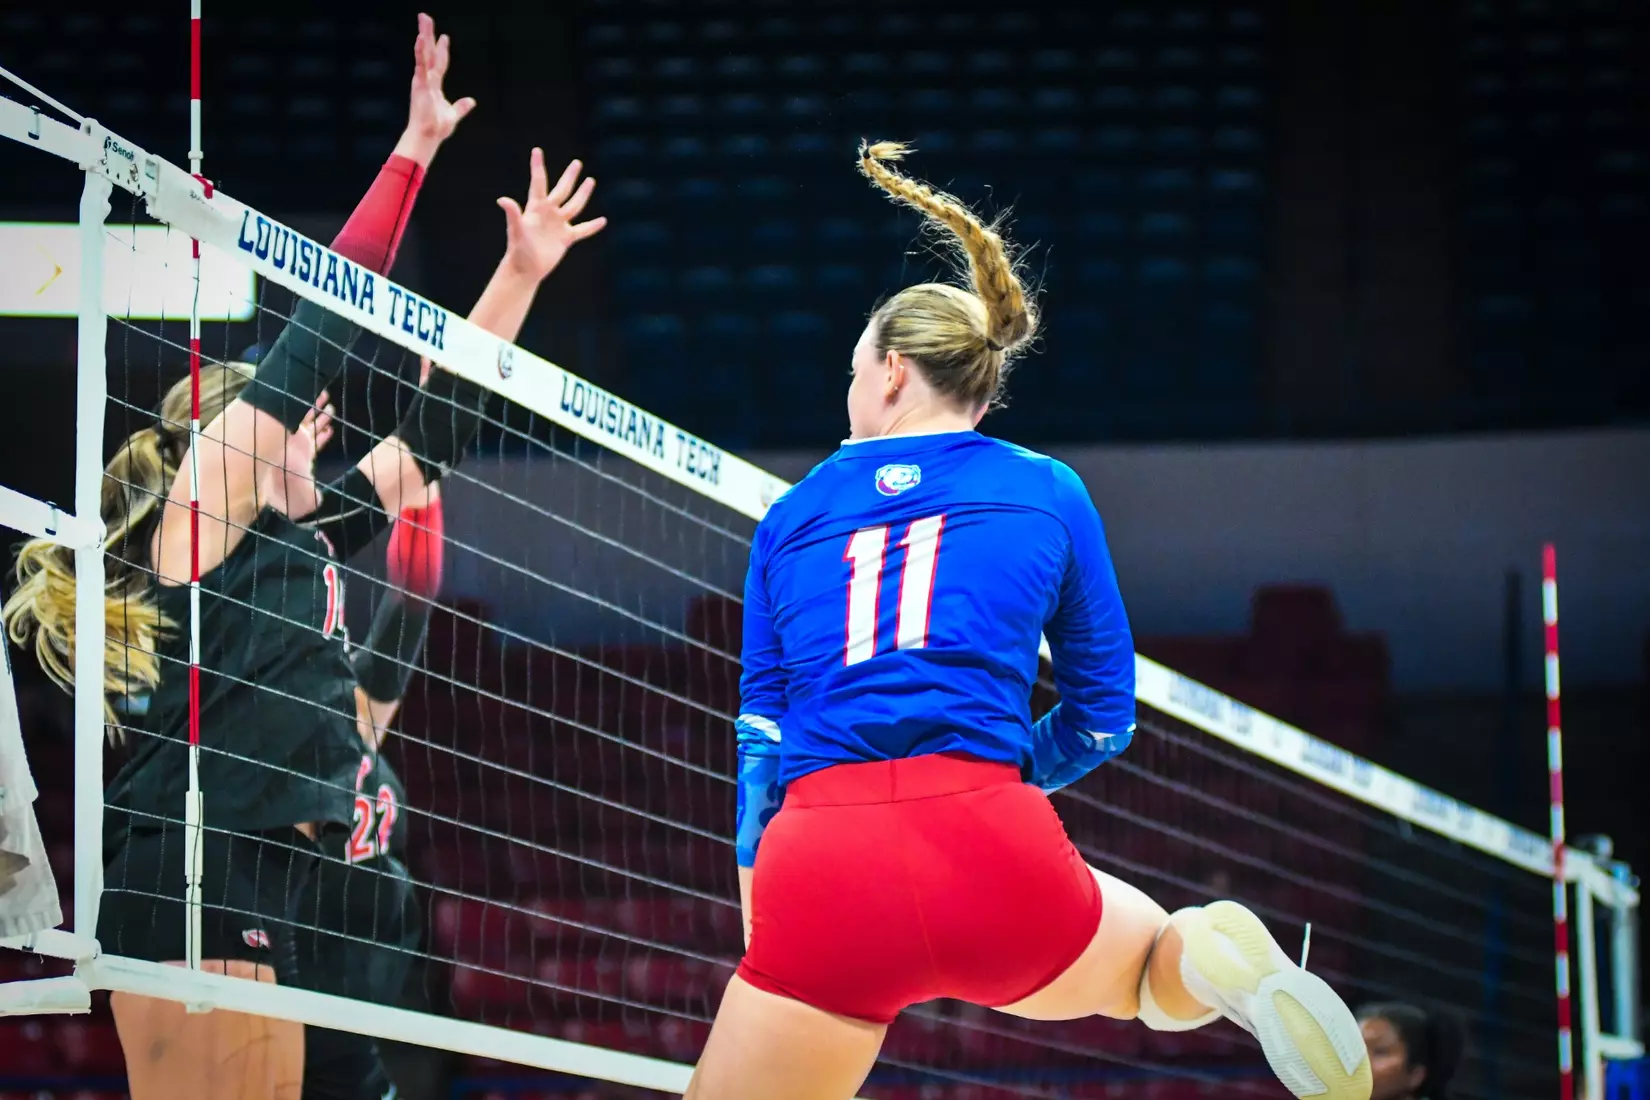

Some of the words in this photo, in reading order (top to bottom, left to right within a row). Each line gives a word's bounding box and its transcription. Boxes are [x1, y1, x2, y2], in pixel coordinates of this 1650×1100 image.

[237, 209, 375, 316] LOUISIANA
[388, 285, 447, 351] TECH
[559, 372, 665, 460] LOUISIANA
[675, 432, 723, 486] TECH
[842, 513, 947, 668] 11
